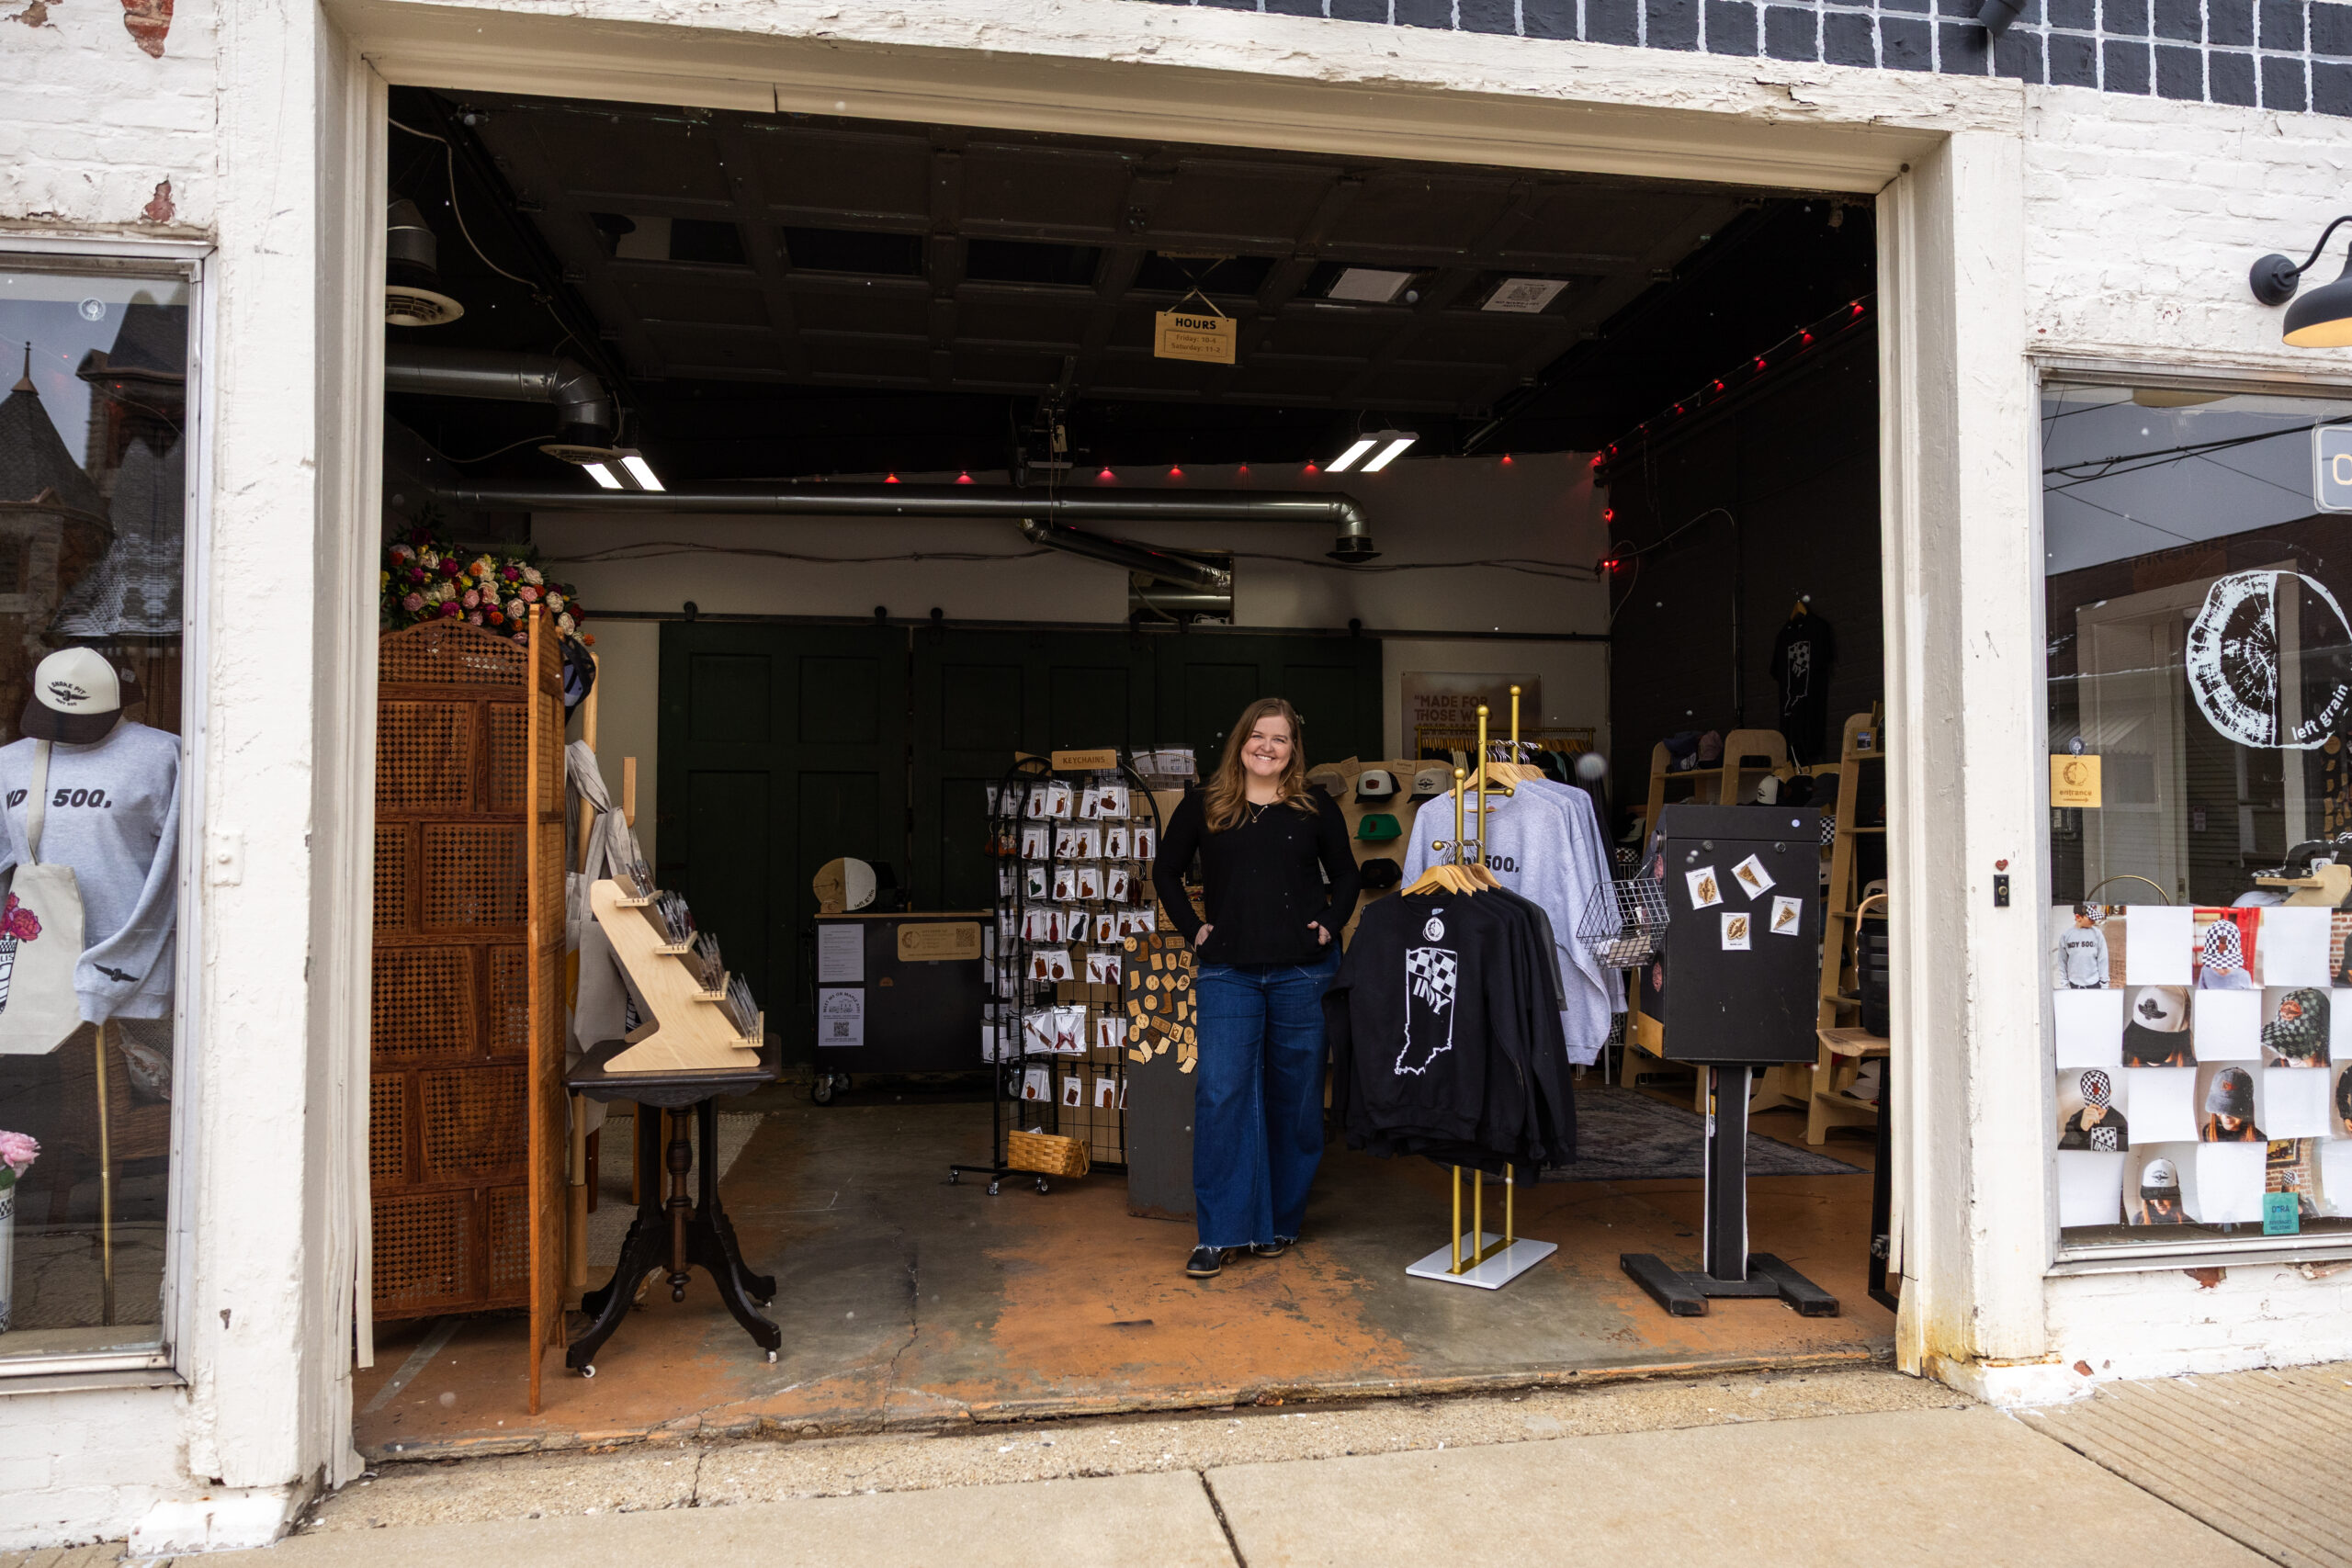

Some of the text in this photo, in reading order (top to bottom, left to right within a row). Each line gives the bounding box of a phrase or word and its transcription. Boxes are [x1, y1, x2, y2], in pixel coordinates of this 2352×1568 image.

[1175, 318, 1216, 330] HOURS
[1176, 334, 1199, 344] Friday:
[1171, 342, 1204, 352] Saturday:
[51, 681, 86, 694] SNAKE PIT
[1415, 709, 1457, 722] THOSE
[2291, 683, 2348, 741] left grain
[1062, 756, 1105, 764] KEYCHAINS
[1412, 976, 1451, 1014] INDY
